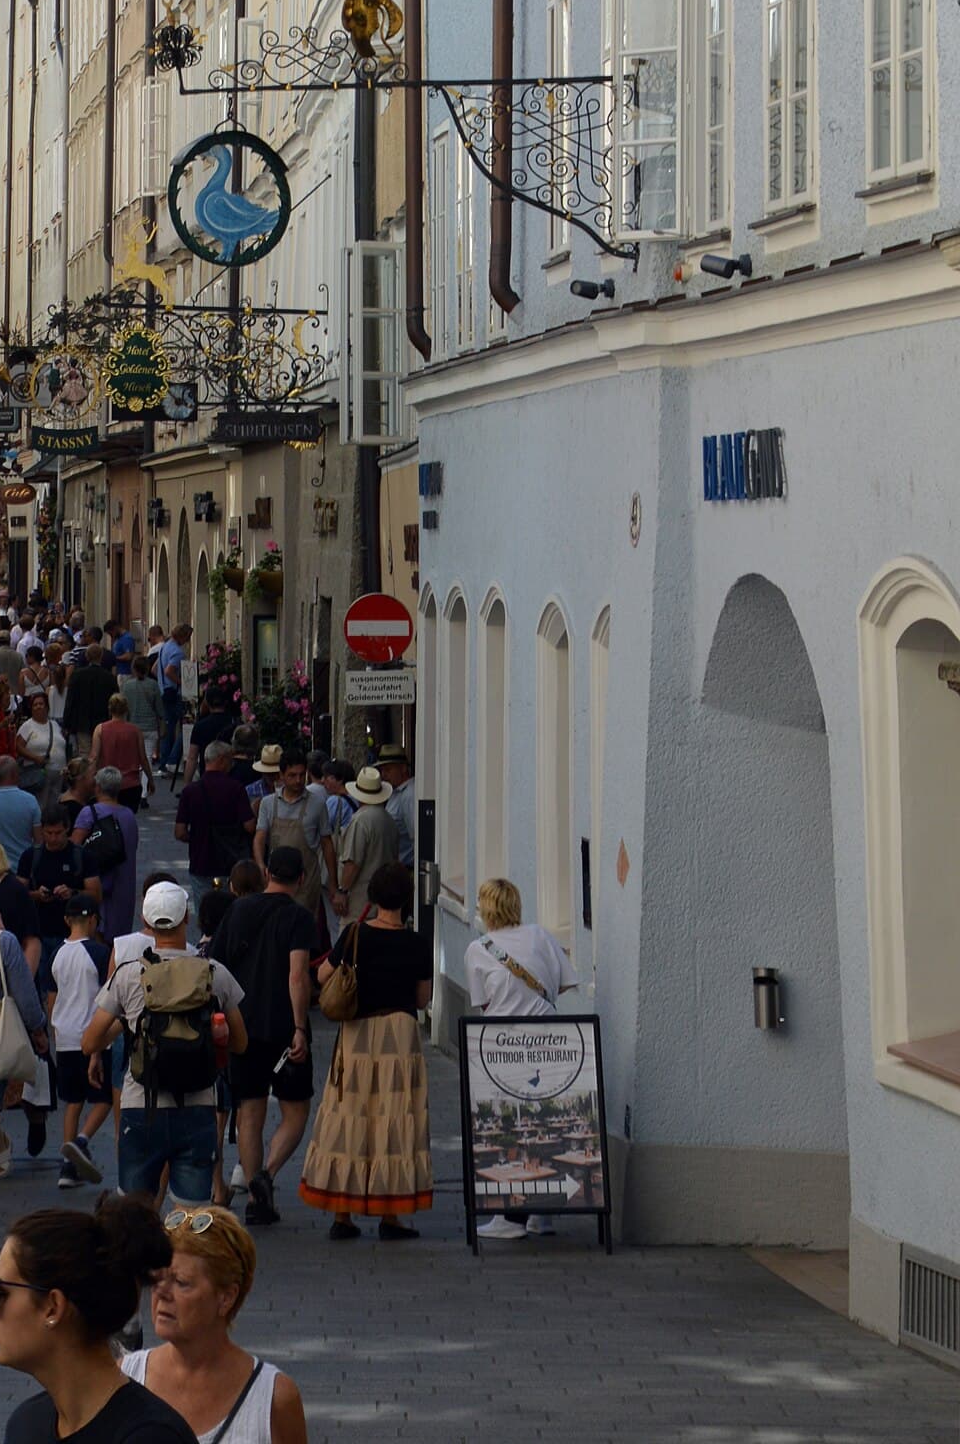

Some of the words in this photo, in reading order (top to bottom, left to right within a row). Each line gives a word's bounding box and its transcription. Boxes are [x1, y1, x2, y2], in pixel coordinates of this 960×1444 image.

[125, 345, 150, 356] Hotel
[119, 362, 157, 375] Goldener
[224, 424, 314, 437] SPIRITUOSEN
[37, 433, 93, 450] STASSNY
[350, 675, 409, 683] ausgenommen
[358, 683, 402, 691] Taxizufahrt
[347, 693, 384, 702] Goldener
[386, 692, 413, 701] Hirsch
[496, 1031, 568, 1048] Gastgarten
[486, 1050, 525, 1065] OUTDOOR
[527, 1049, 578, 1064] RESTAURANT
